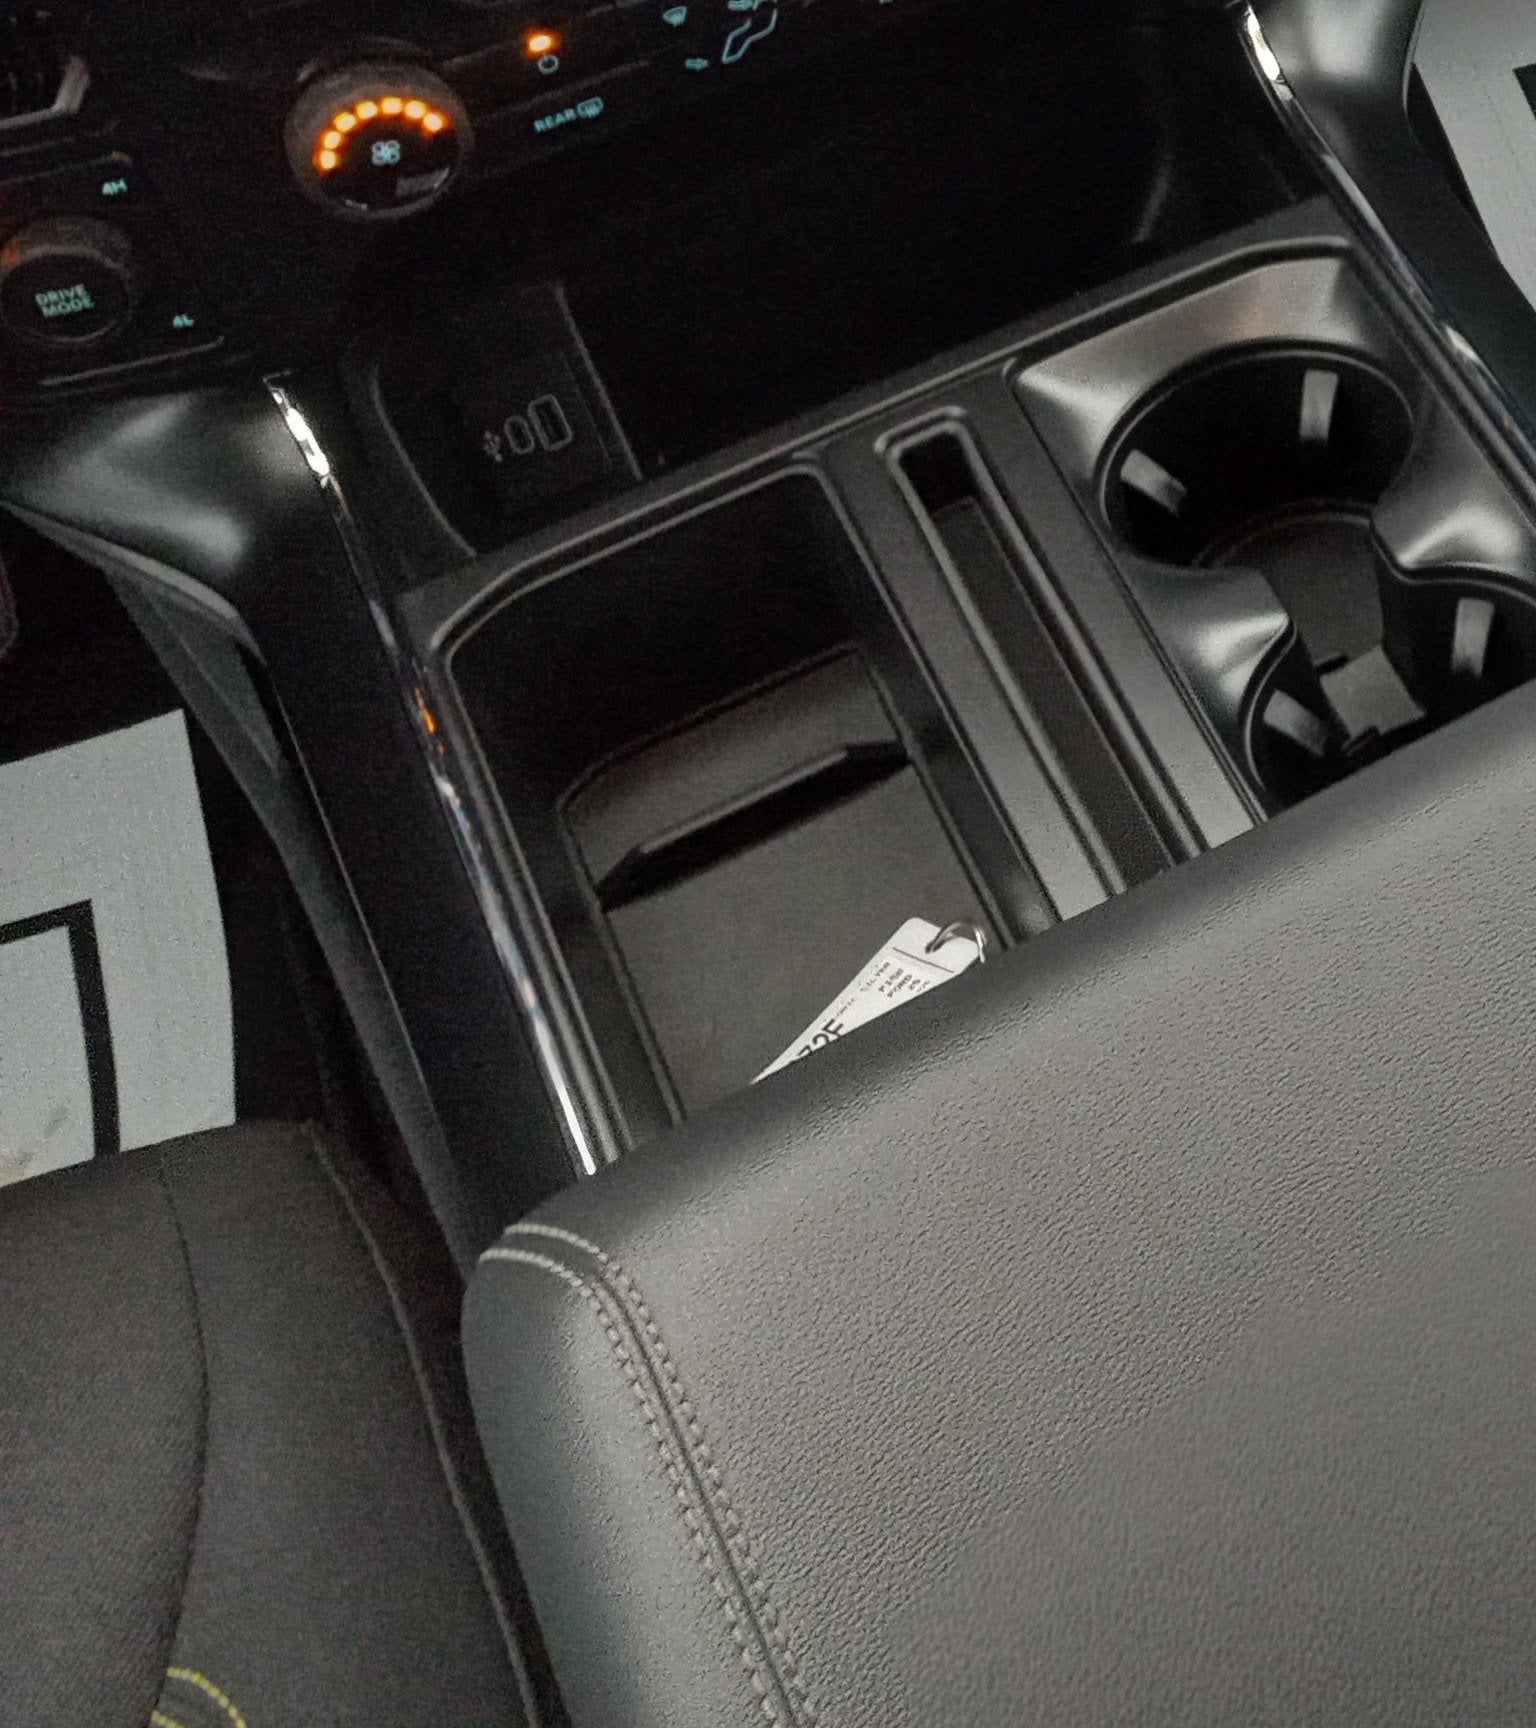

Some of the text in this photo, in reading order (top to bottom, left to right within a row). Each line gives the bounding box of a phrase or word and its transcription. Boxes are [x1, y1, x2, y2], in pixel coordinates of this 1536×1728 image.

[534, 108, 576, 133] REAR
[35, 282, 87, 308] DRIVE
[41, 293, 96, 317] MODE
